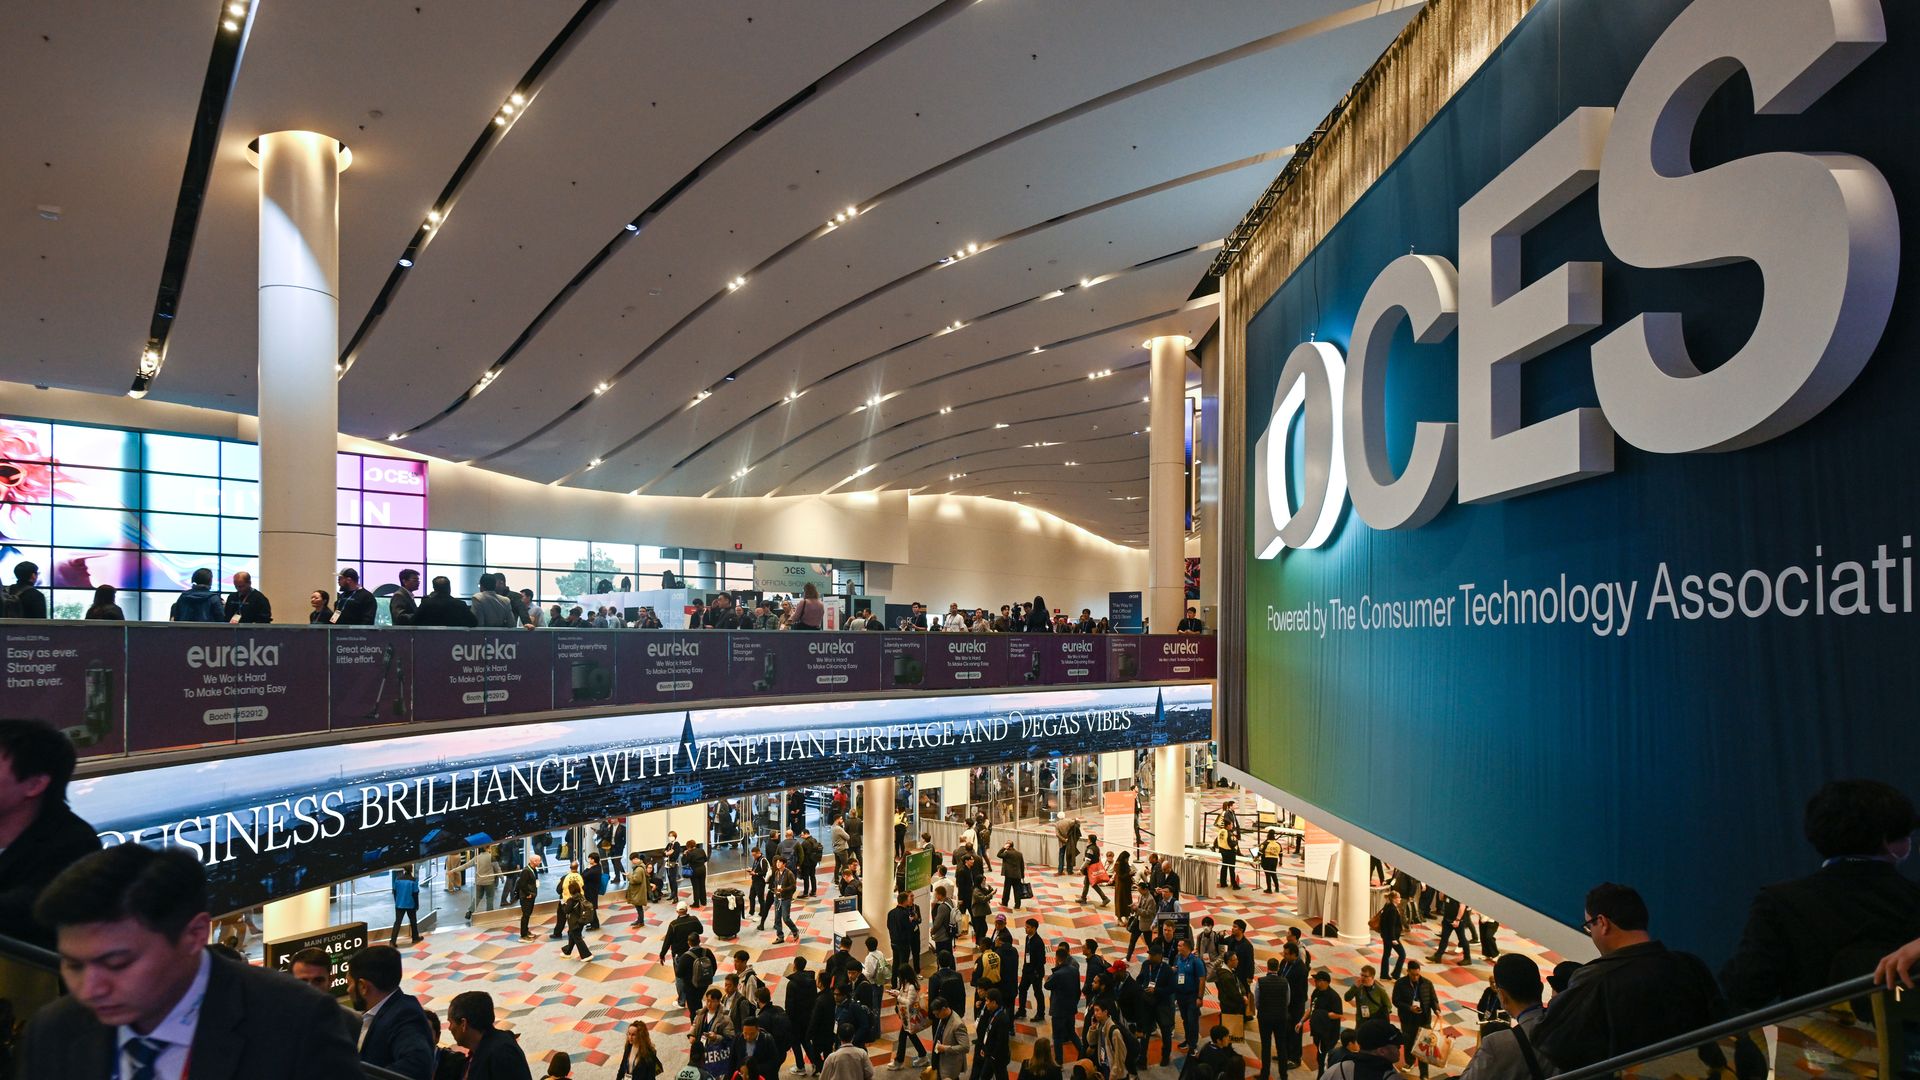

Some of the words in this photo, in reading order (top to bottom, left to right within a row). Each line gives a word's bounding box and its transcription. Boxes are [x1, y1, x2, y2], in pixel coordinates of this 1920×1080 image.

[1343, 0, 1900, 530] CES
[350, 500, 390, 526] IN
[1268, 602, 1310, 632] Powered
[1314, 602, 1328, 638] by
[1330, 598, 1356, 630] The
[1360, 595, 1456, 630] Consumer
[1458, 573, 1638, 636] Technology
[1646, 535, 1912, 620] Associati
[187, 638, 279, 668] eureka
[336, 646, 358, 654] Great
[360, 646, 382, 654] clean,
[452, 638, 516, 662] eureka
[647, 638, 699, 657] eureka
[808, 638, 854, 654] eureka
[948, 639, 986, 653] eureka
[1062, 640, 1093, 653] eureka
[1163, 639, 1199, 655] eureka
[7, 648, 36, 660] Easy
[36, 649, 50, 658] as
[52, 649, 78, 658] ever.
[336, 656, 353, 664] little
[354, 656, 376, 664] effort.
[7, 662, 56, 674] Stronger
[8, 678, 34, 688] than
[38, 678, 62, 687] ever.
[202, 674, 218, 684] We
[219, 674, 244, 683] Work
[244, 672, 266, 682] Hard
[458, 675, 476, 683] Make
[508, 673, 522, 682] Easy
[184, 688, 194, 698] To
[196, 688, 222, 698] Make
[224, 686, 264, 696] Cleaning
[266, 684, 287, 694] Easy
[209, 712, 232, 721] Booth
[358, 754, 580, 830] BRILLIANCE
[589, 744, 675, 786] WITH
[684, 730, 826, 772] VENETIAN
[835, 720, 954, 755] HERITAGE
[961, 718, 1008, 744] AND
[1009, 710, 1080, 738] VEGAS
[1085, 710, 1132, 732] VIBES
[304, 938, 322, 948] MAIN
[324, 933, 346, 944] FLOOR
[325, 945, 333, 954] A
[335, 943, 342, 953] B
[344, 940, 352, 950] C
[354, 938, 362, 947] D
[341, 962, 349, 972] G
